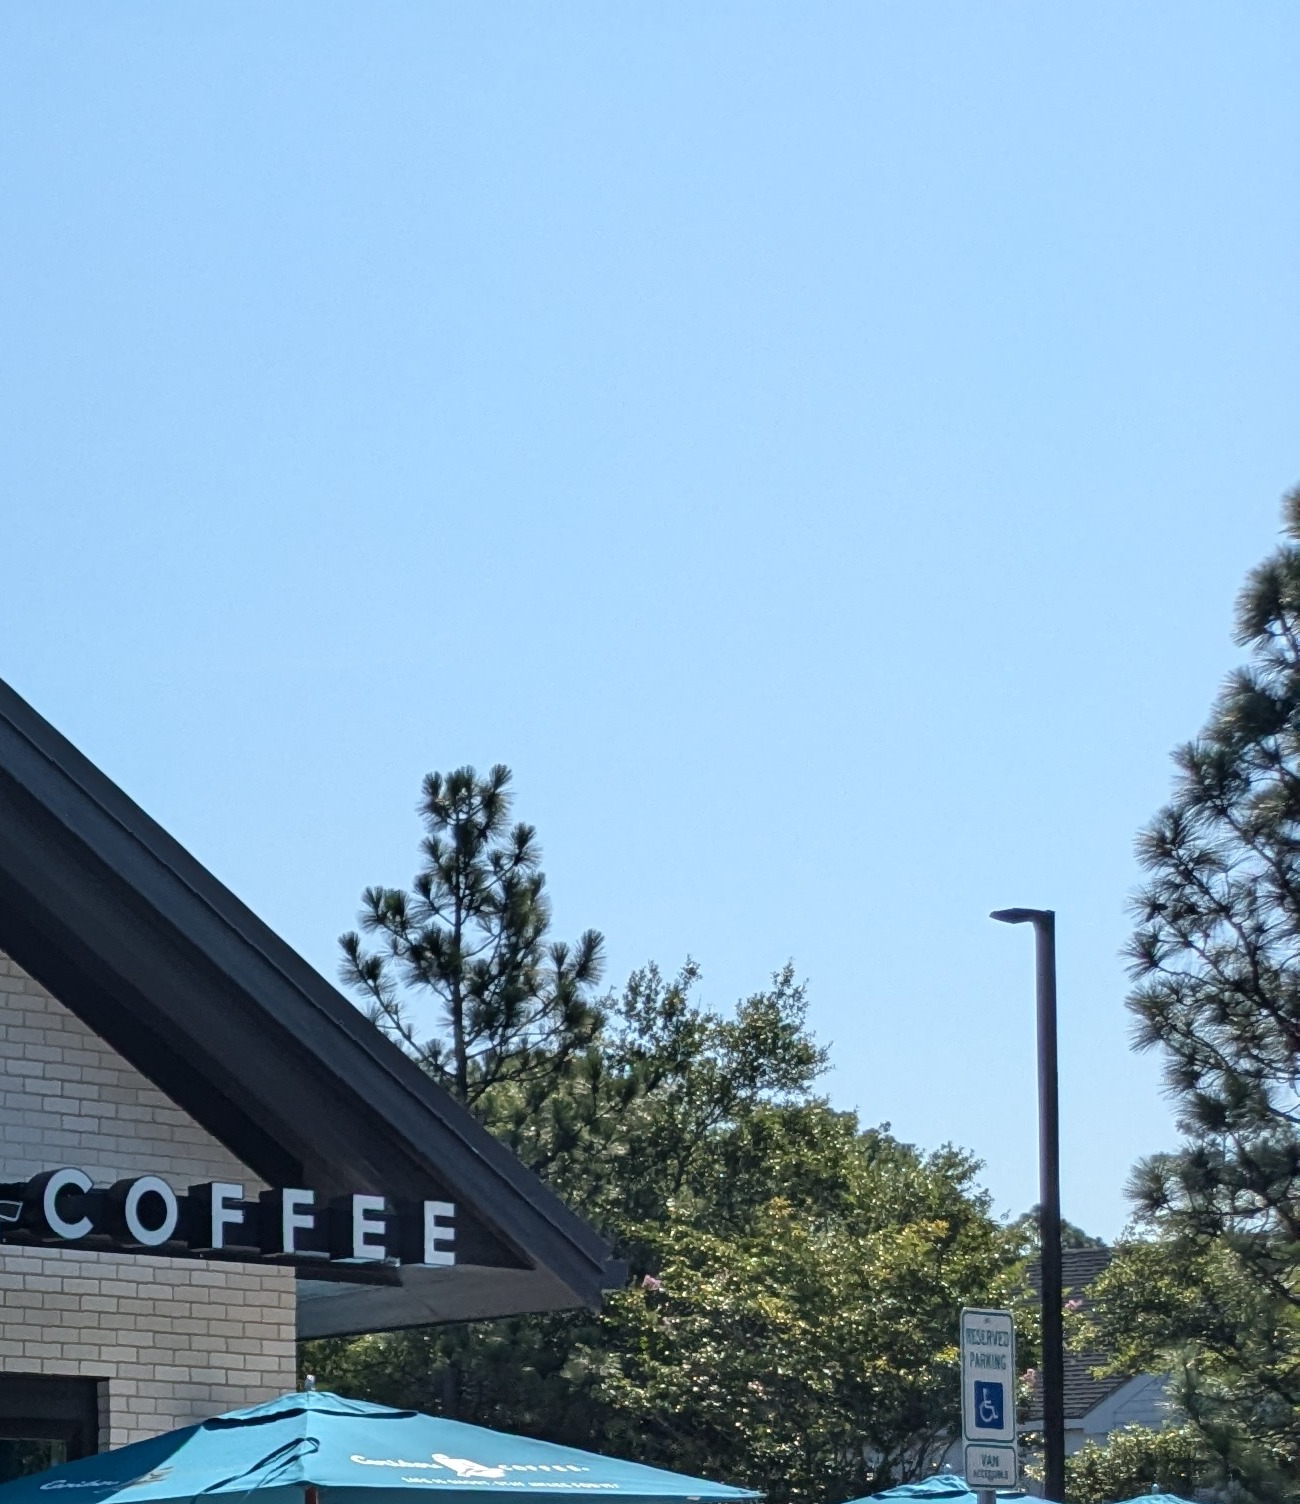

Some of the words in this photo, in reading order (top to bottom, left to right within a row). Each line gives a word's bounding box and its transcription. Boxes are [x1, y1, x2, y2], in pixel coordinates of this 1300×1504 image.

[43, 1166, 456, 1266] COFFEE
[966, 1327, 1009, 1347] RESERVED
[970, 1351, 1006, 1370] PARKING
[981, 1454, 999, 1467] VAN
